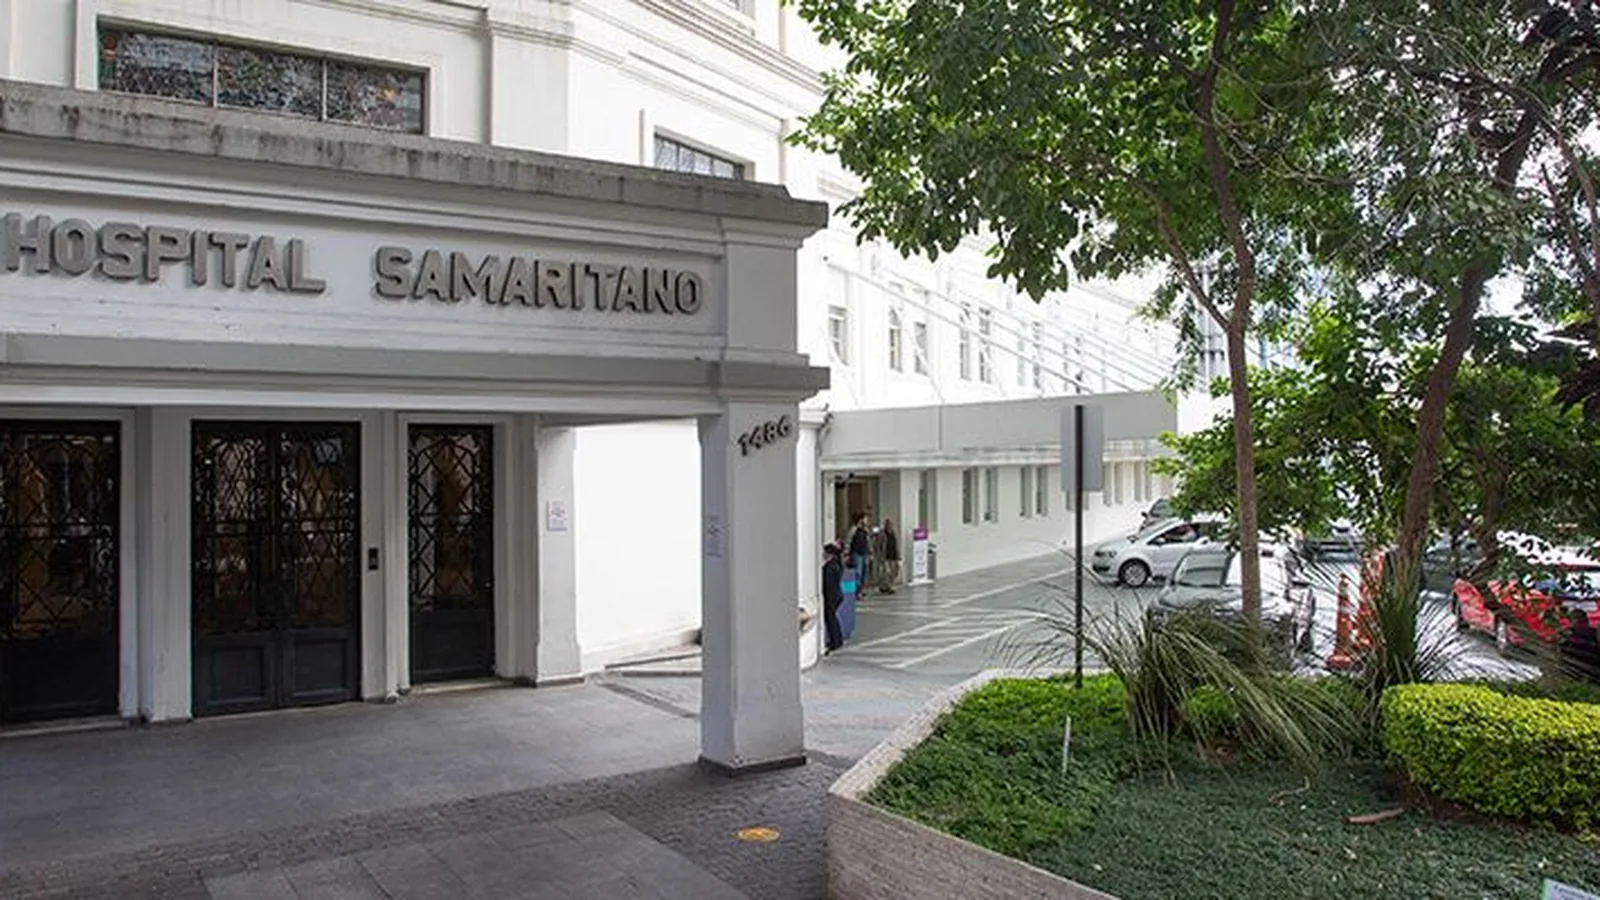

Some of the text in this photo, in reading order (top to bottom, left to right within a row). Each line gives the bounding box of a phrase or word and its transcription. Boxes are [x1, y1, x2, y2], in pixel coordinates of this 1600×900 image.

[4, 212, 703, 315] HOSPITAL SAMARITANO
[737, 415, 791, 457] 1486
